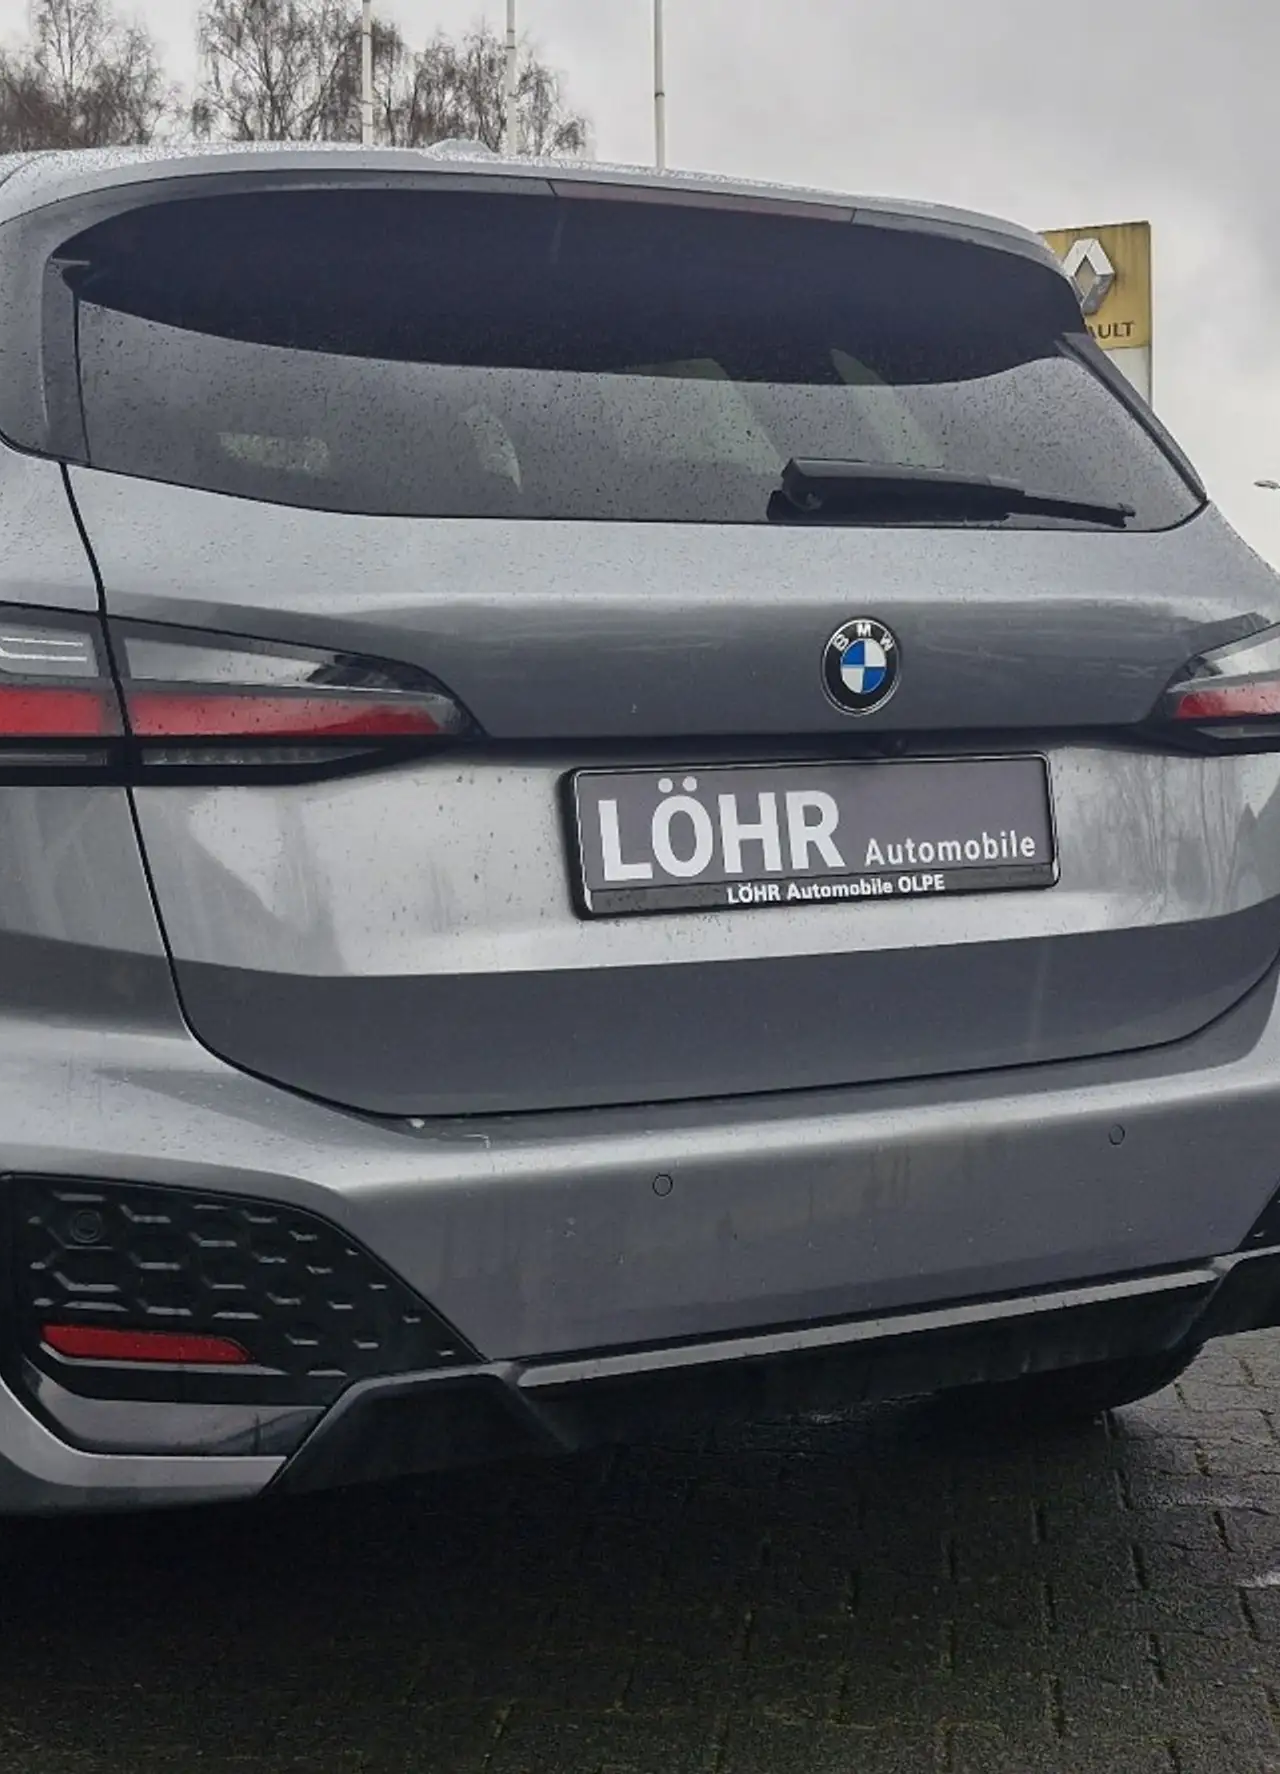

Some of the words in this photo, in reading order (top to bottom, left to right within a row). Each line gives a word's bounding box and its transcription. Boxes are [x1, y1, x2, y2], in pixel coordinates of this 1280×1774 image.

[831, 623, 895, 652] BMW
[598, 775, 846, 881] LÖHR
[864, 830, 1036, 867] Automobile
[726, 882, 780, 904] LÖHR
[786, 878, 893, 901] Automobile
[898, 874, 946, 893] OLPE
